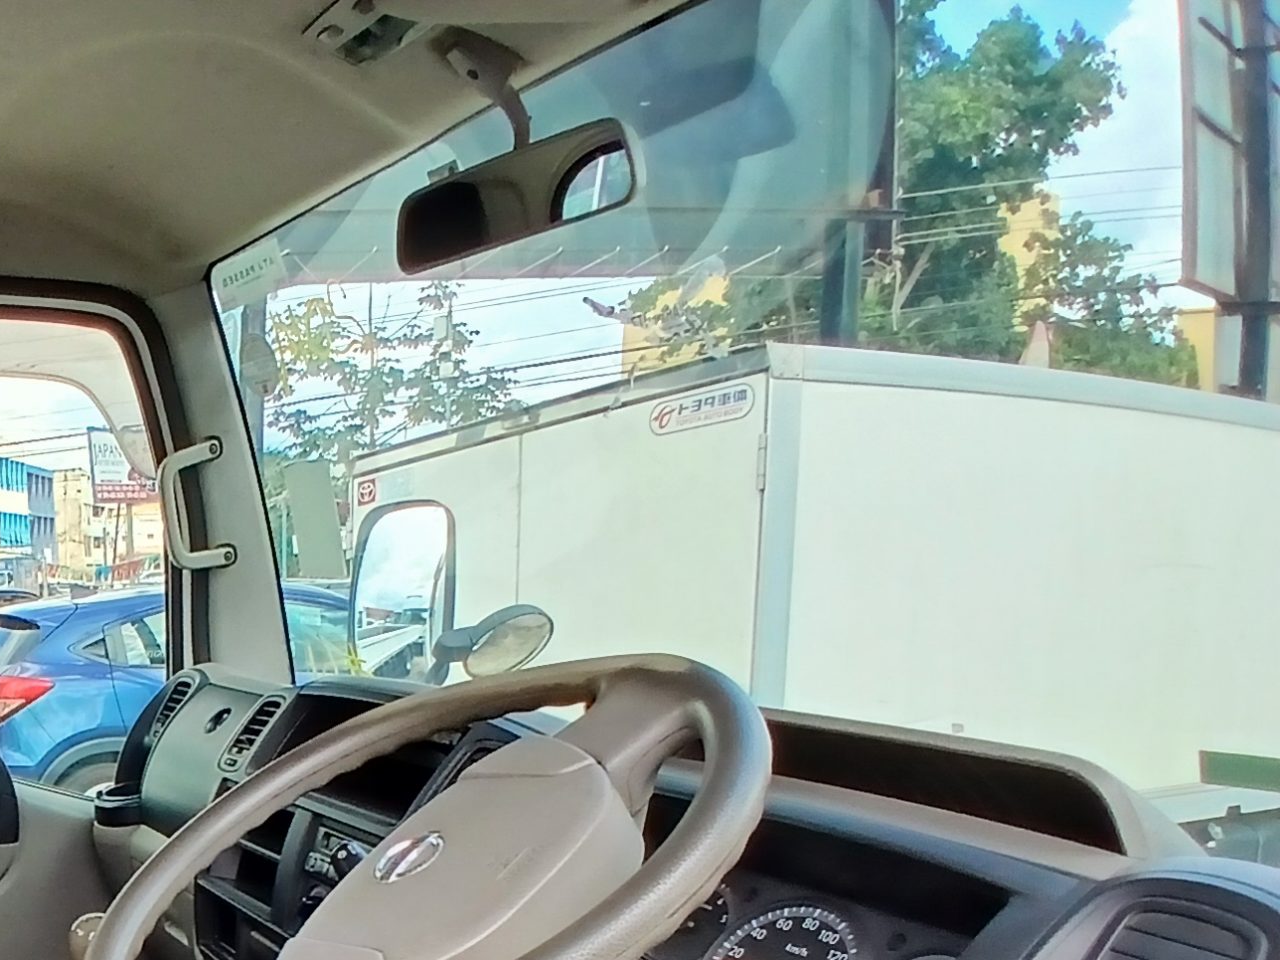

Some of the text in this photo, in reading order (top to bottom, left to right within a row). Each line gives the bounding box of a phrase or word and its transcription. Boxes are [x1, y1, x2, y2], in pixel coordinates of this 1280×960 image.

[776, 918, 793, 931] 60
[801, 917, 820, 931] 80
[750, 927, 767, 940] 40
[817, 929, 840, 945] 100
[728, 945, 745, 959] 20
[785, 943, 808, 957] km/h
